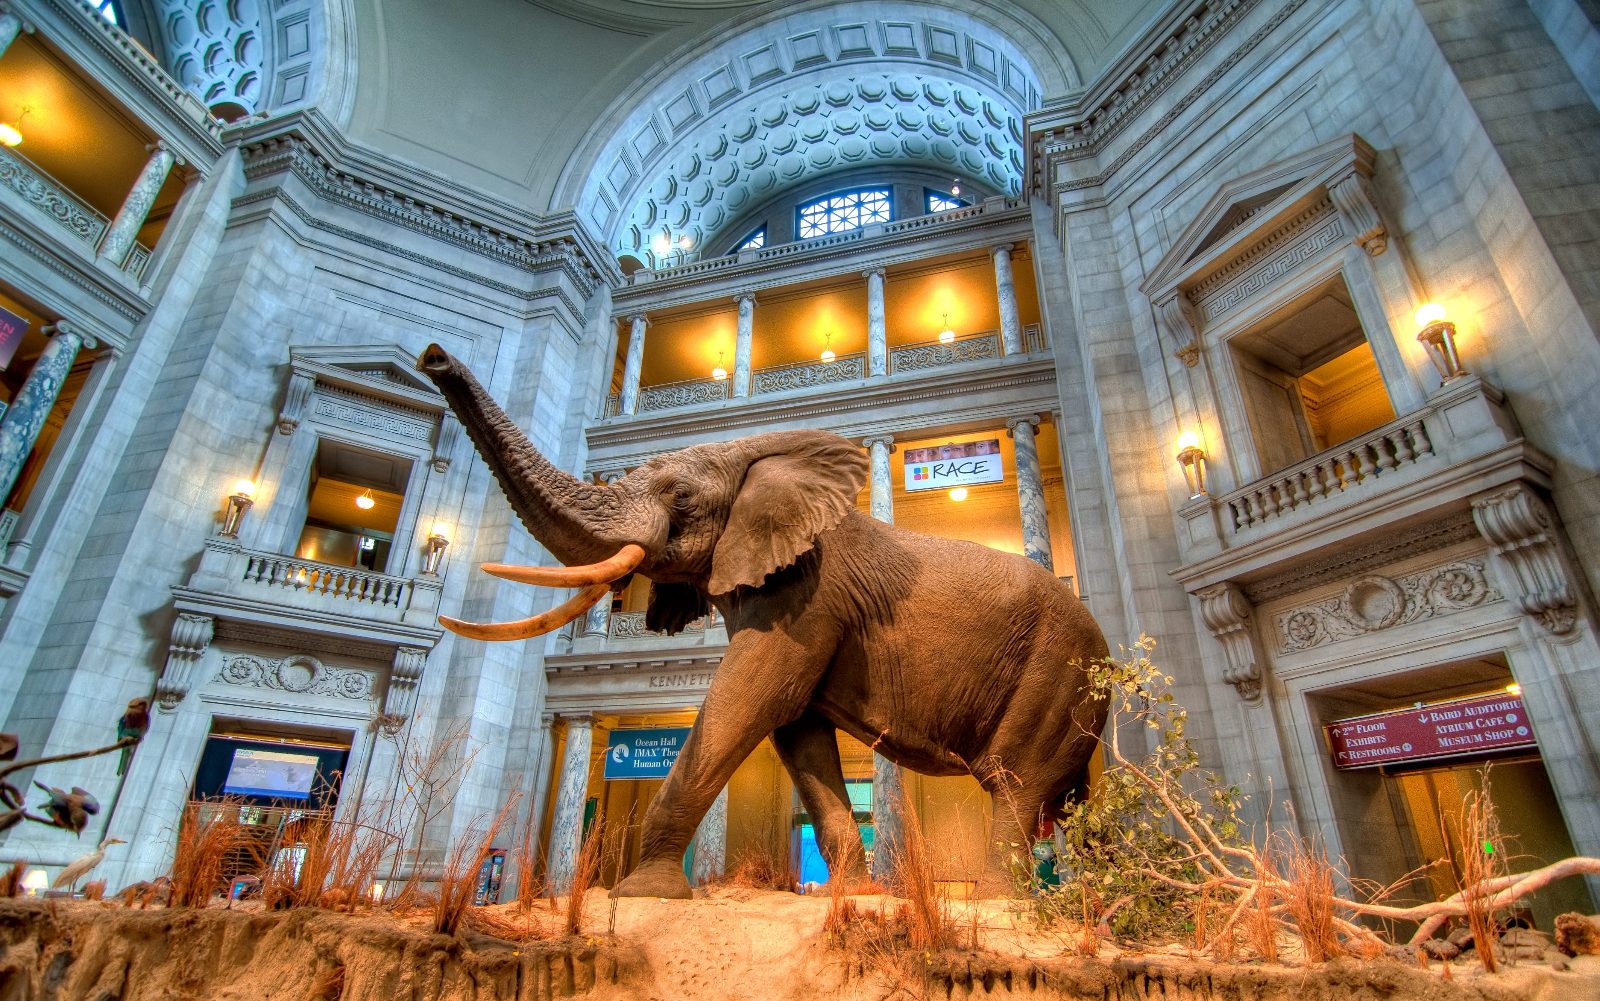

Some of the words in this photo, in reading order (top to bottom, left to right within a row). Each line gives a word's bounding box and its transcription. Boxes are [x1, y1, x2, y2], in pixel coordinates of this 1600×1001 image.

[933, 460, 990, 479] RACE
[1430, 710, 1461, 722] BAIRD
[1356, 722, 1386, 734] FLOOR
[1436, 722, 1474, 734] ATRIUM
[1476, 716, 1504, 728] CAFE
[635, 738, 658, 747] Ocean
[660, 737, 676, 746] Hall
[1346, 736, 1386, 748] EXHIBITS
[1439, 734, 1483, 748] MUSEUM
[1485, 730, 1514, 741] SHOP
[1348, 746, 1401, 760] RESTROOMS
[633, 759, 661, 768] Human
